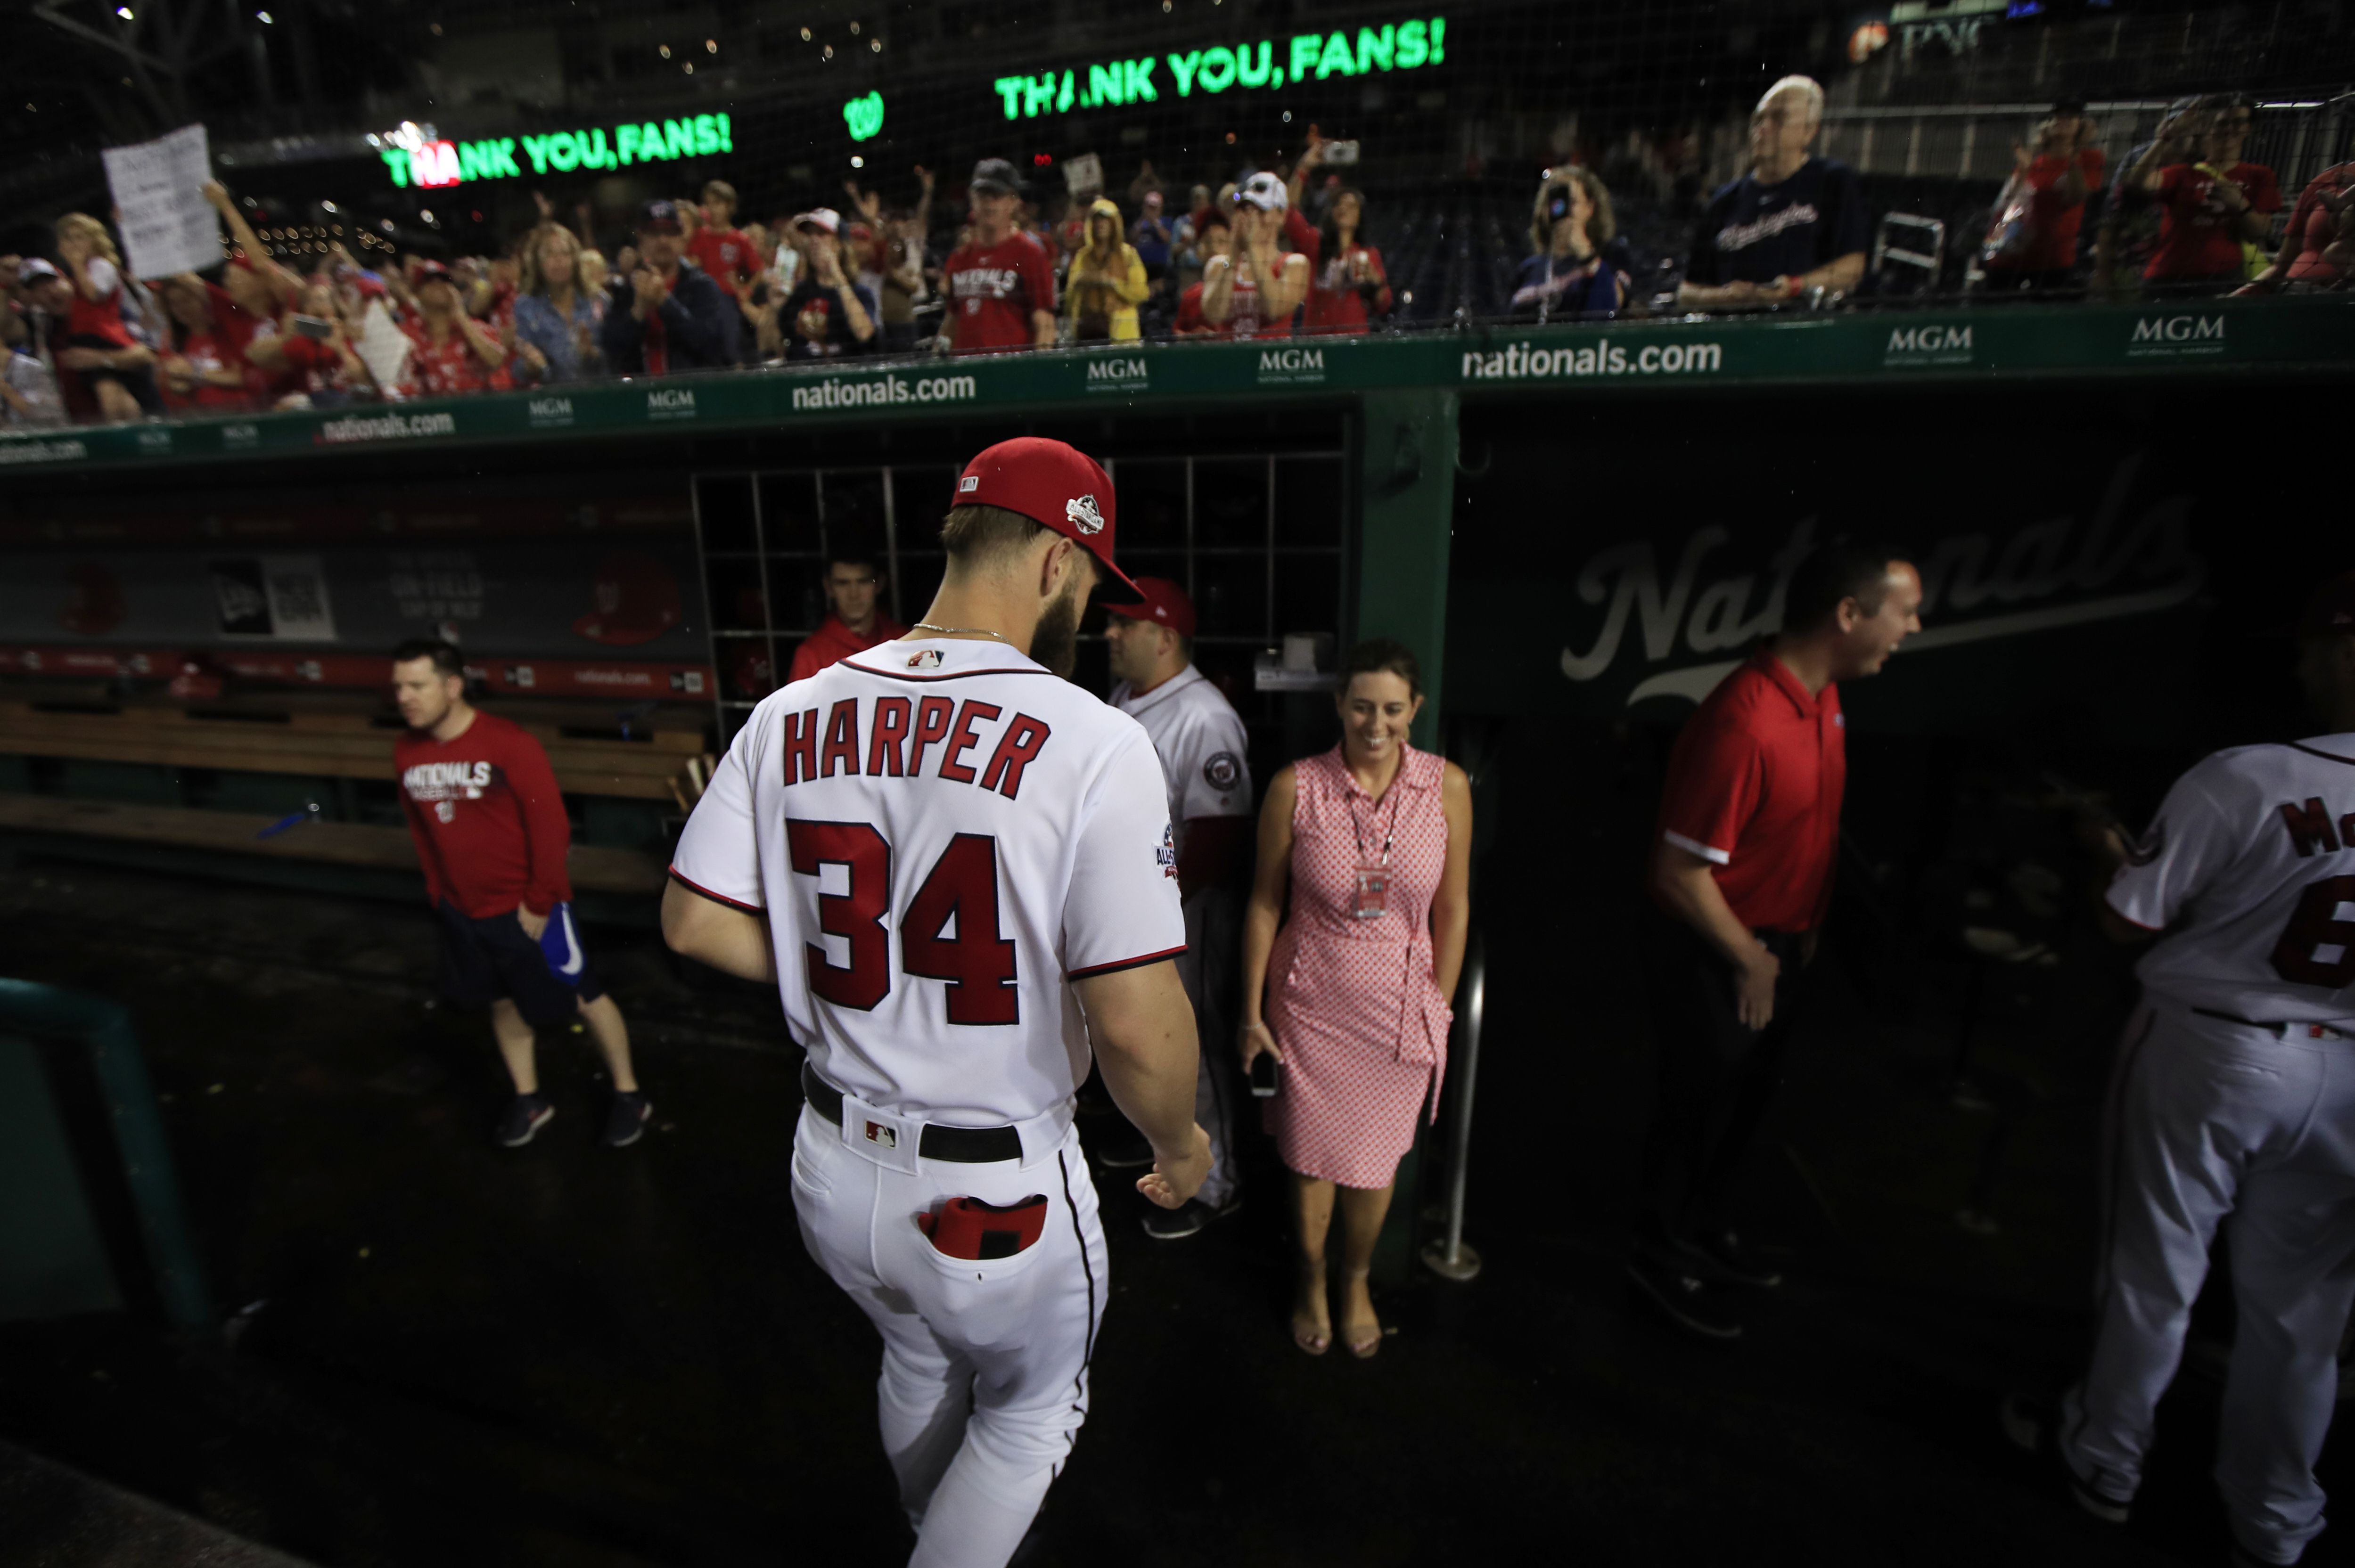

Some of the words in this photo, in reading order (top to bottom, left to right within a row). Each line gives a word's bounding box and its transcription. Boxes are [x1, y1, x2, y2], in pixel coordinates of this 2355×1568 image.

[1167, 40, 1285, 98] YOU,
[1289, 16, 1446, 83] FANS!
[380, 136, 520, 188] THANK
[520, 128, 618, 172] YOU,
[615, 112, 733, 166] FANS!
[1886, 325, 1973, 352] MGM
[2130, 315, 2225, 342] MGM
[1086, 358, 1148, 380] MGM
[1258, 349, 1325, 370] MGM
[1461, 338, 1722, 377] nationals.com
[793, 374, 976, 410] nationals.com
[784, 695, 1051, 801] HARPER
[785, 817, 1020, 1026] 34
